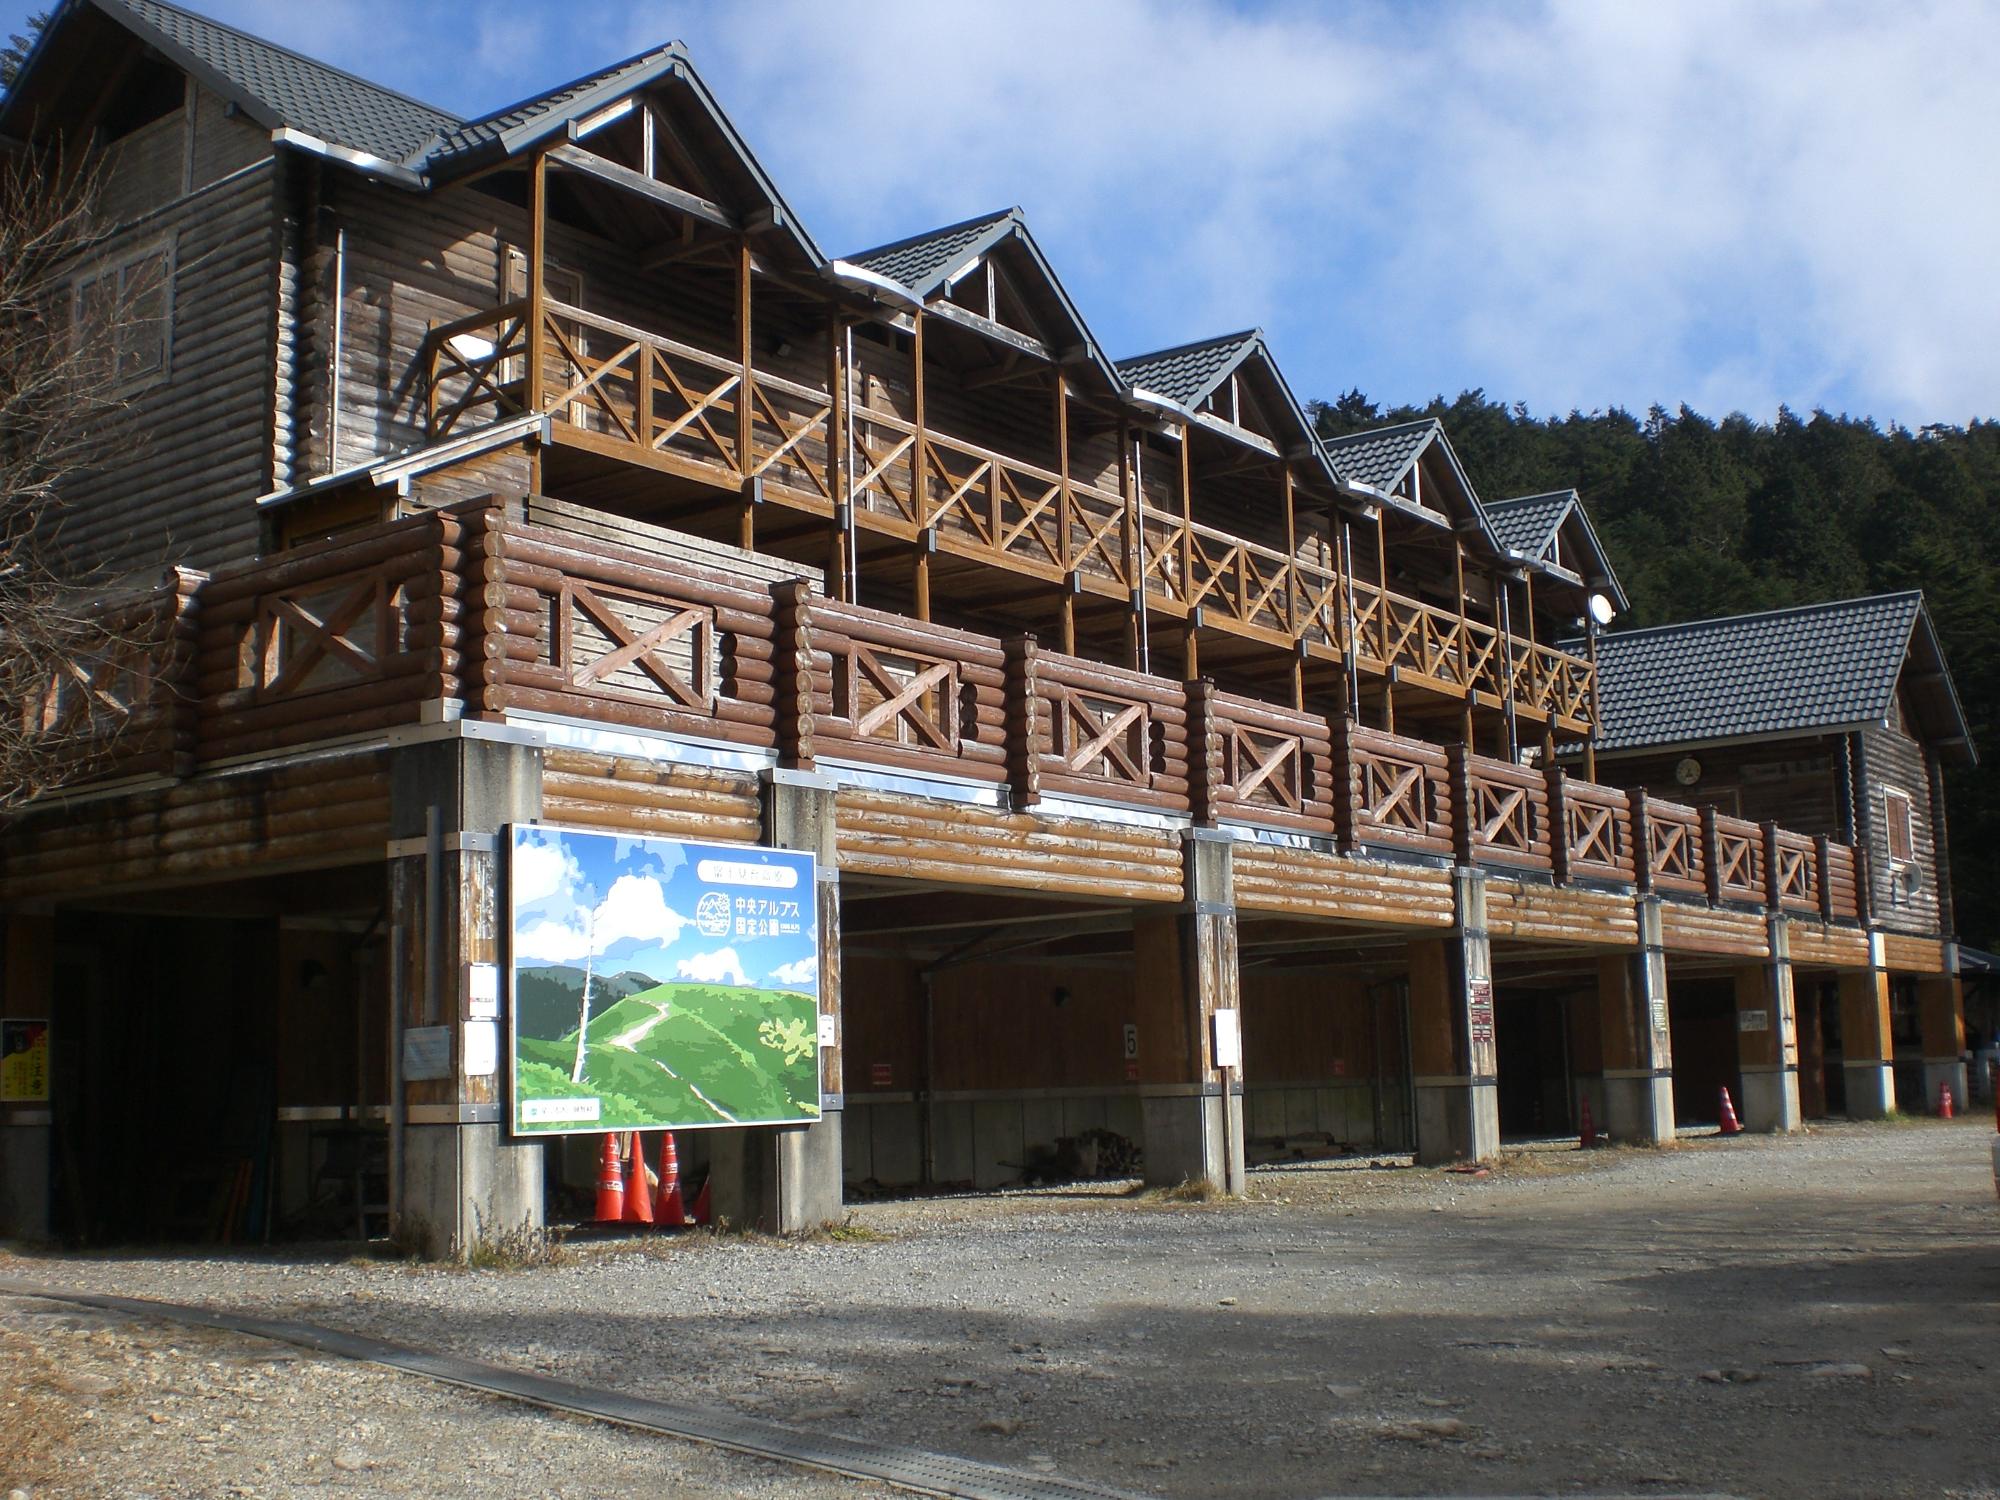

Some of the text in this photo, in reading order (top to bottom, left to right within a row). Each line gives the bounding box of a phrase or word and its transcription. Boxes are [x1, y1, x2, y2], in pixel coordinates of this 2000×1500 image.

[736, 897, 800, 917] 中央アルプス
[736, 917, 779, 937] 国定公園
[1127, 1030, 1136, 1054] 5
